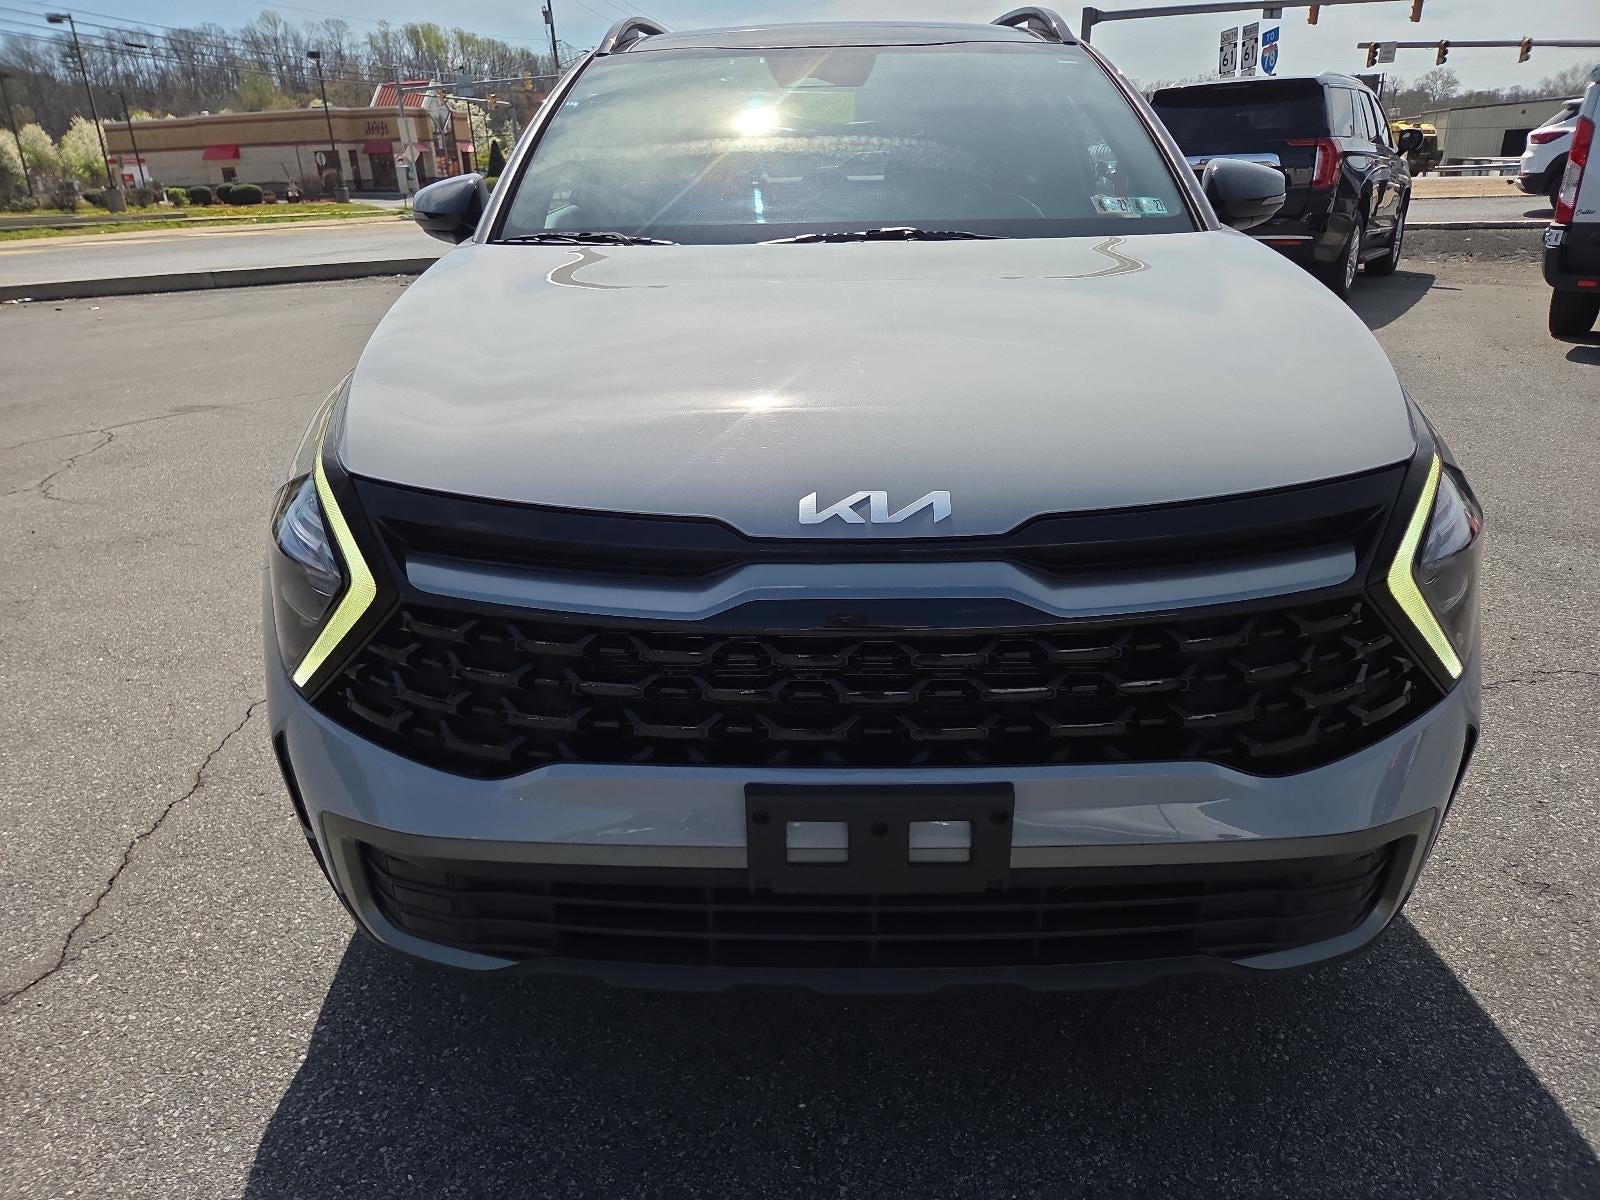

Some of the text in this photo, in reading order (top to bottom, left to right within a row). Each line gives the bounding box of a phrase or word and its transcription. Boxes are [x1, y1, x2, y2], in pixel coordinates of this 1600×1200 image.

[1222, 32, 1237, 43] SOUTH
[1266, 32, 1275, 42] TO
[1222, 51, 1234, 67] 61
[1244, 45, 1254, 61] 61
[1264, 51, 1276, 68] 78
[799, 490, 952, 524] KIA
